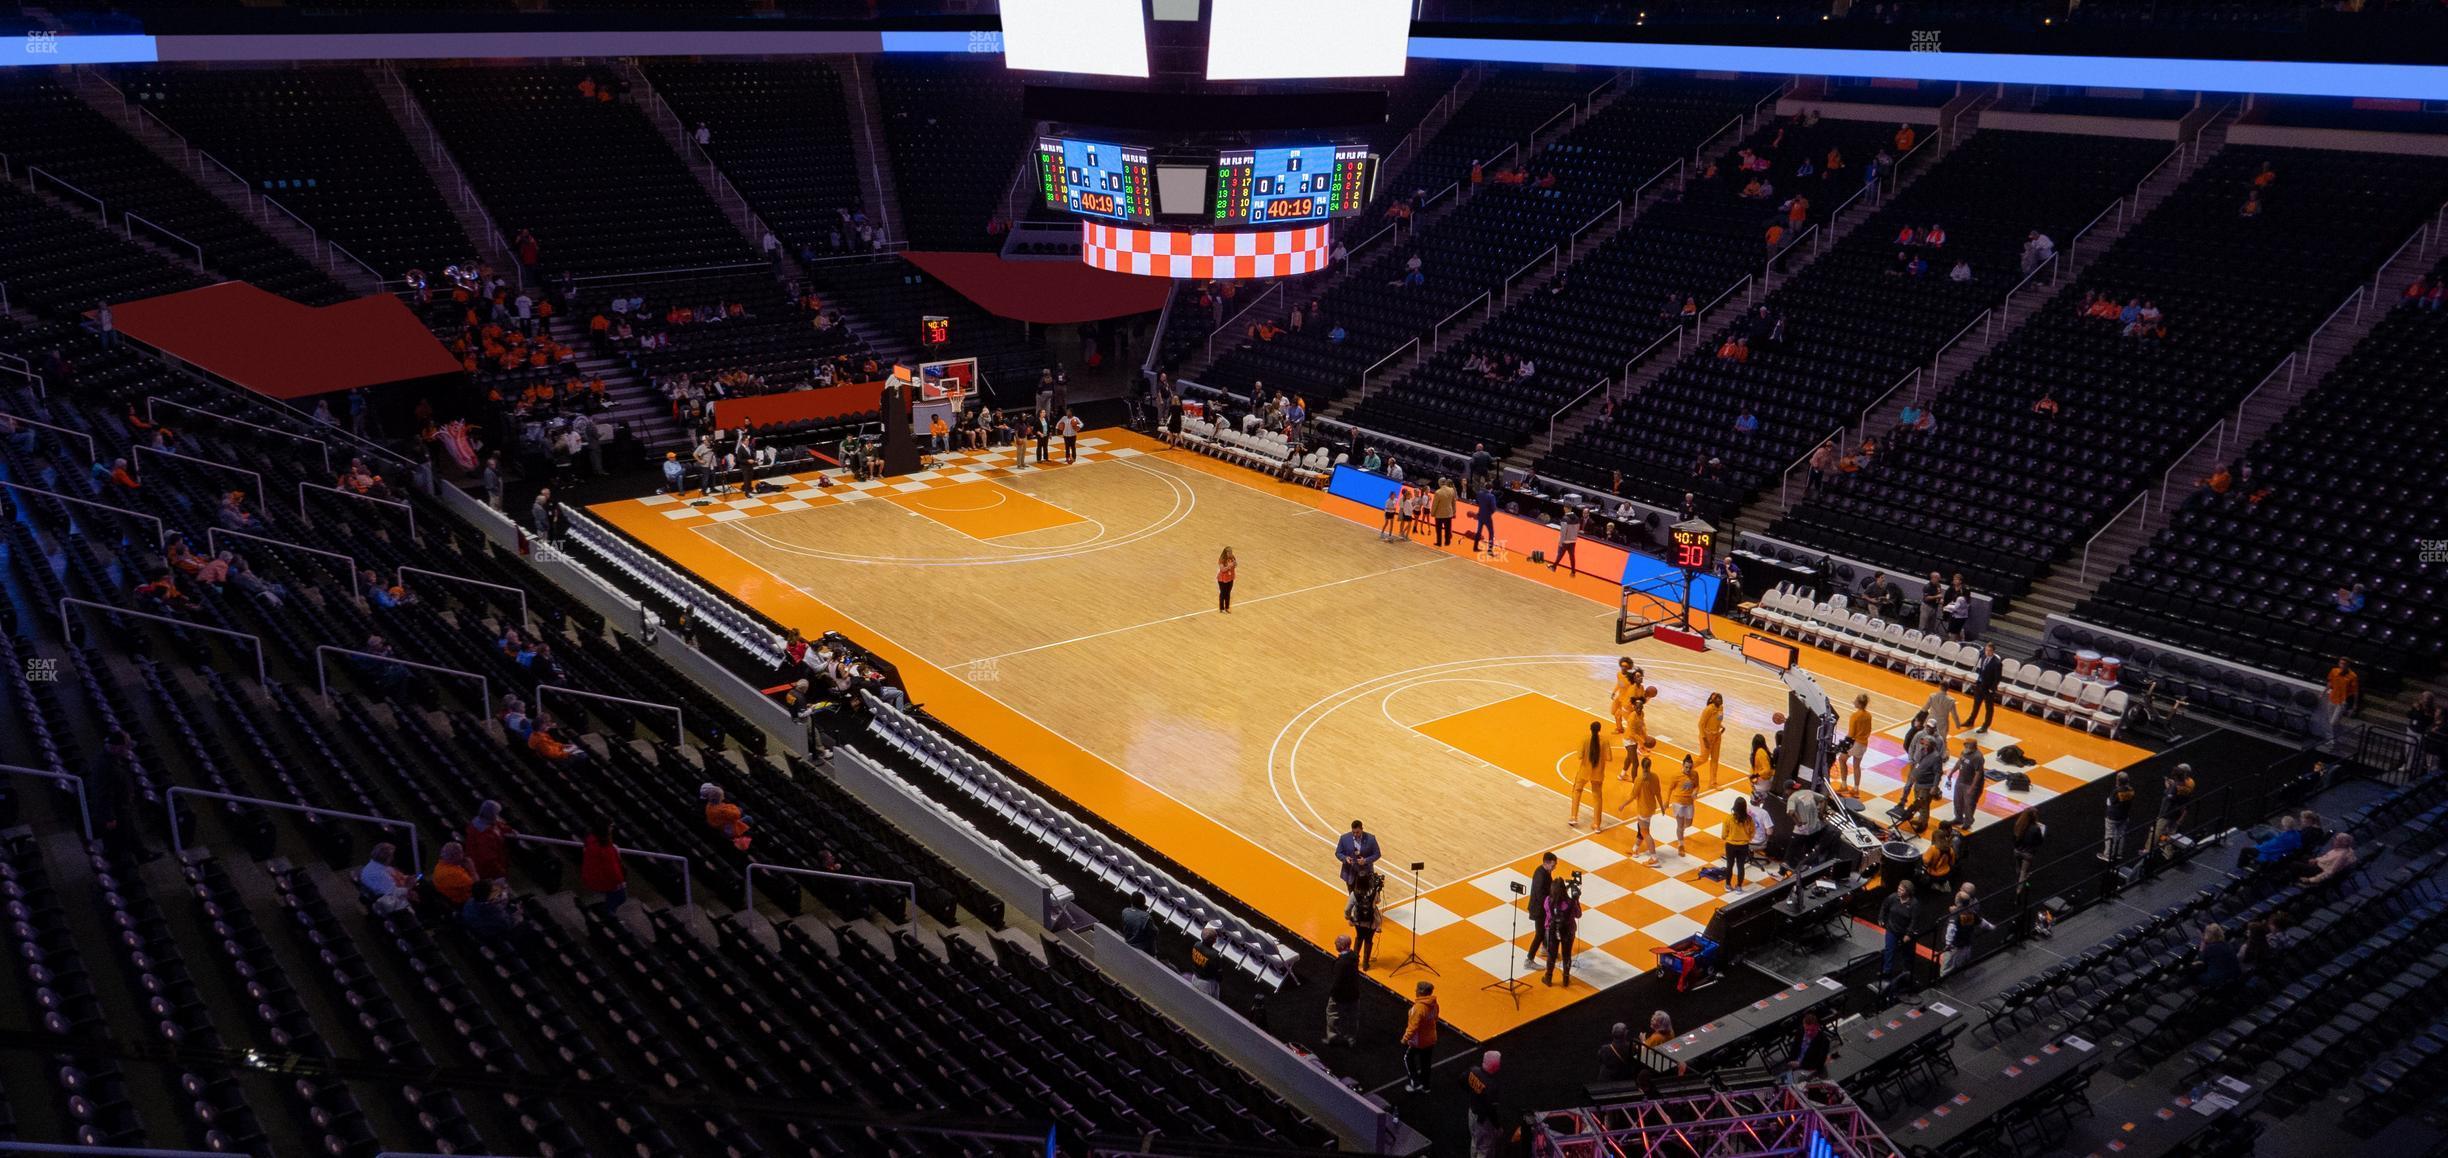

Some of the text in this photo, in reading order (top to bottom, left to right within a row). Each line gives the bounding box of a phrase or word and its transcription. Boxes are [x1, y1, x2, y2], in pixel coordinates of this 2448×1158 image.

[1090, 155, 1095, 166] 1
[1292, 160, 1296, 170] 1
[1072, 171, 1077, 183] 0
[1085, 178, 1089, 186] 4
[1112, 176, 1118, 189] 0
[1102, 180, 1106, 189] 4
[1261, 180, 1267, 192] 0
[1301, 183, 1306, 191] 4
[1317, 177, 1324, 189] 0
[1278, 185, 1283, 193] 4
[1063, 195, 1067, 203] 0
[1082, 193, 1113, 213] 40:19
[1118, 207, 1122, 215] 0
[1268, 199, 1311, 217] 40:19
[1317, 206, 1322, 214] 0
[1255, 211, 1261, 219] 0
[932, 328, 945, 342] 30
[1674, 532, 1709, 546] 40:19
[1679, 544, 1703, 566] 30
